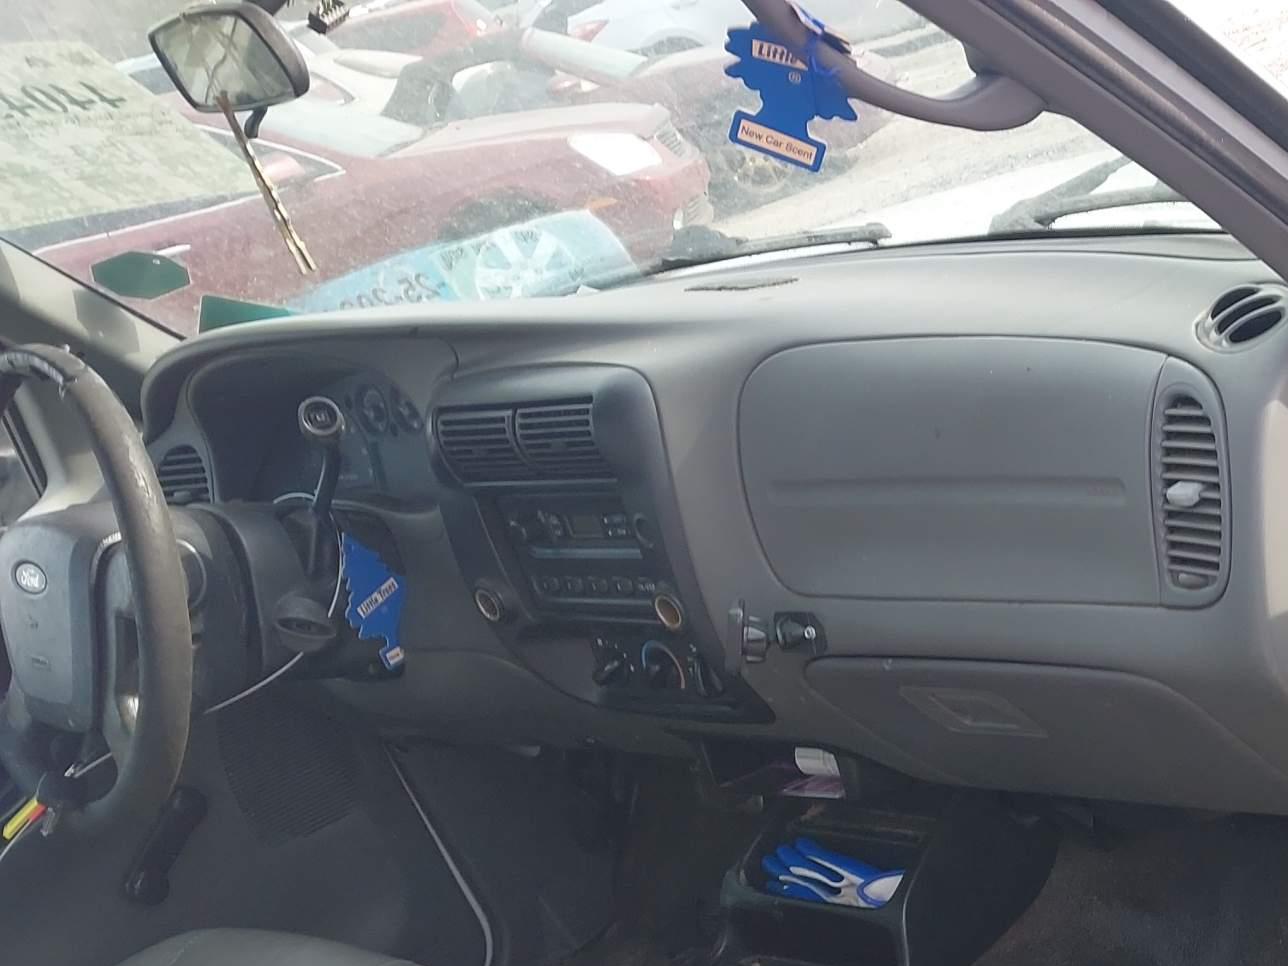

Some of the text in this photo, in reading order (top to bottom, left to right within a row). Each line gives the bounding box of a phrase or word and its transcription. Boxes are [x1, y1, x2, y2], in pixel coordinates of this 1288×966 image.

[740, 124, 814, 161] New Car Scent
